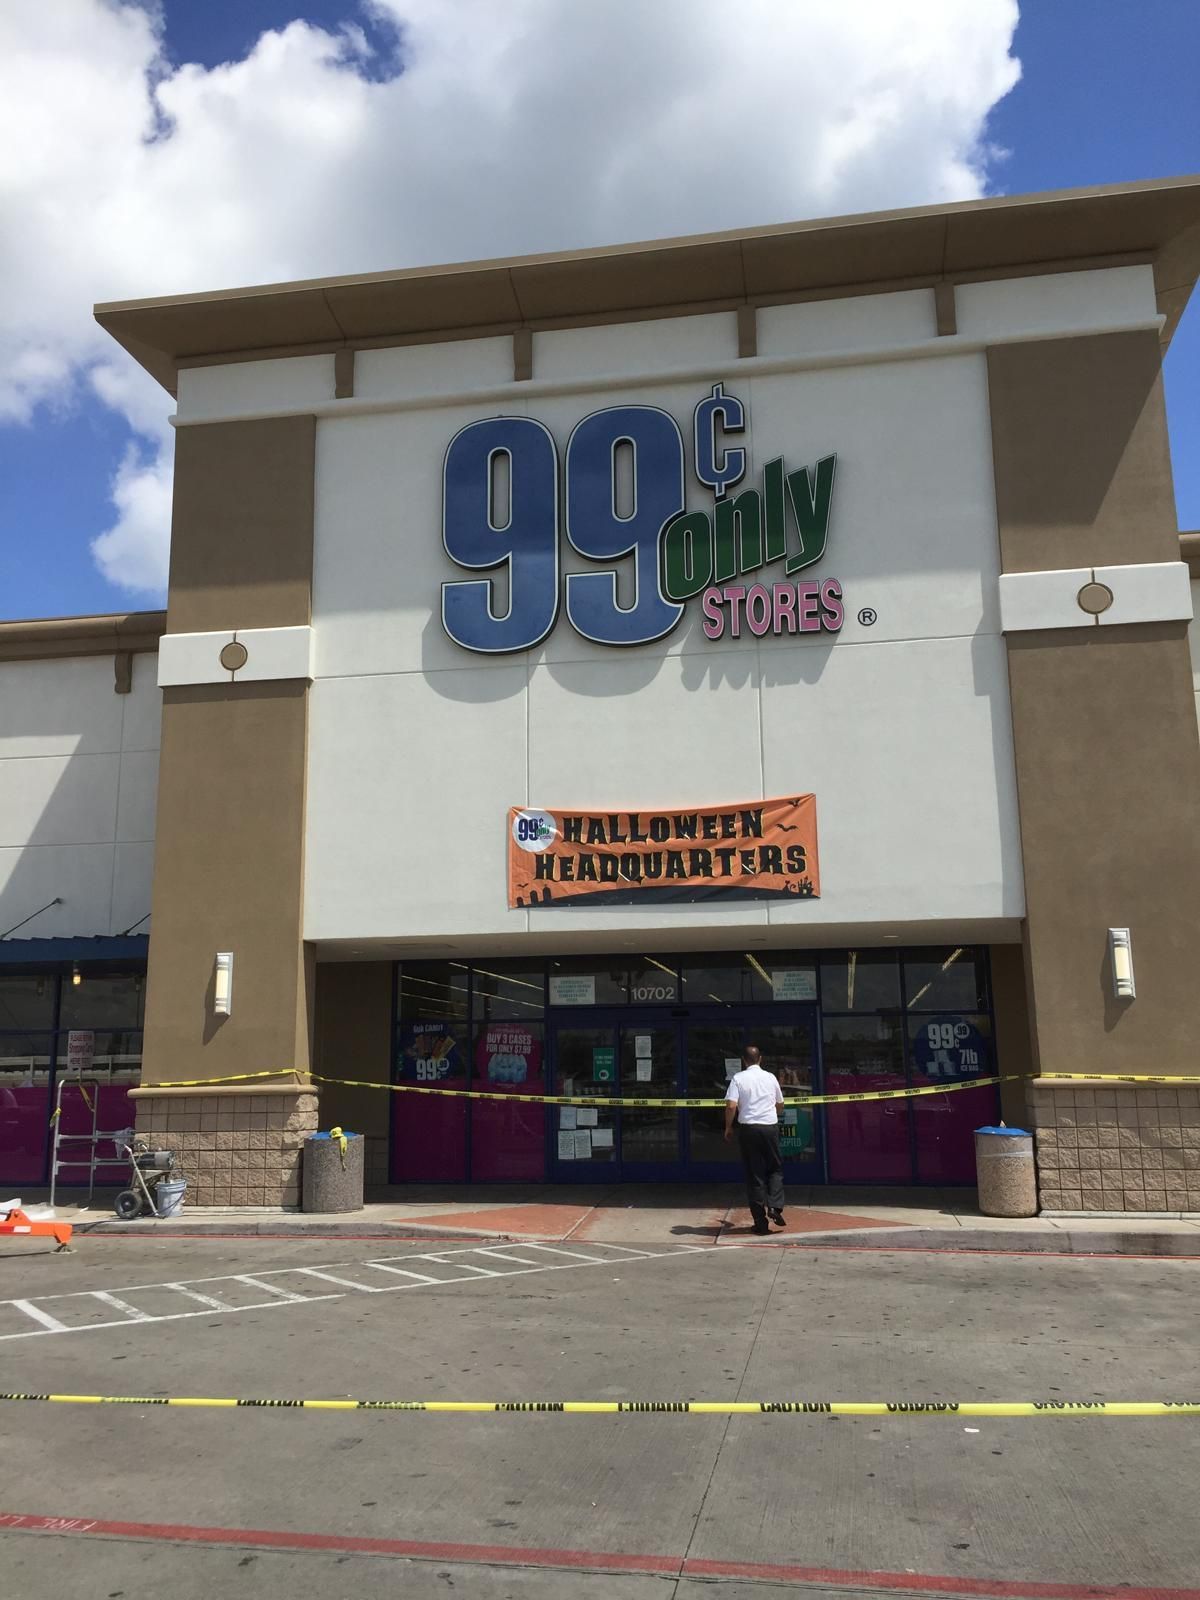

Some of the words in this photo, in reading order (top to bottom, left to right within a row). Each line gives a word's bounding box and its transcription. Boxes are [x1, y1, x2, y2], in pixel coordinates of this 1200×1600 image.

[662, 453, 837, 600] only
[702, 577, 844, 640] STORES
[561, 808, 764, 846] HALLOWEEN
[533, 845, 807, 882] HEADQUARTERS
[632, 987, 675, 1000] 10702
[486, 1044, 498, 1052] FOR
[498, 1044, 514, 1053] ONLY
[487, 1033, 501, 1043] BUY
[502, 1034, 508, 1044] 3
[508, 1034, 532, 1045] CASES
